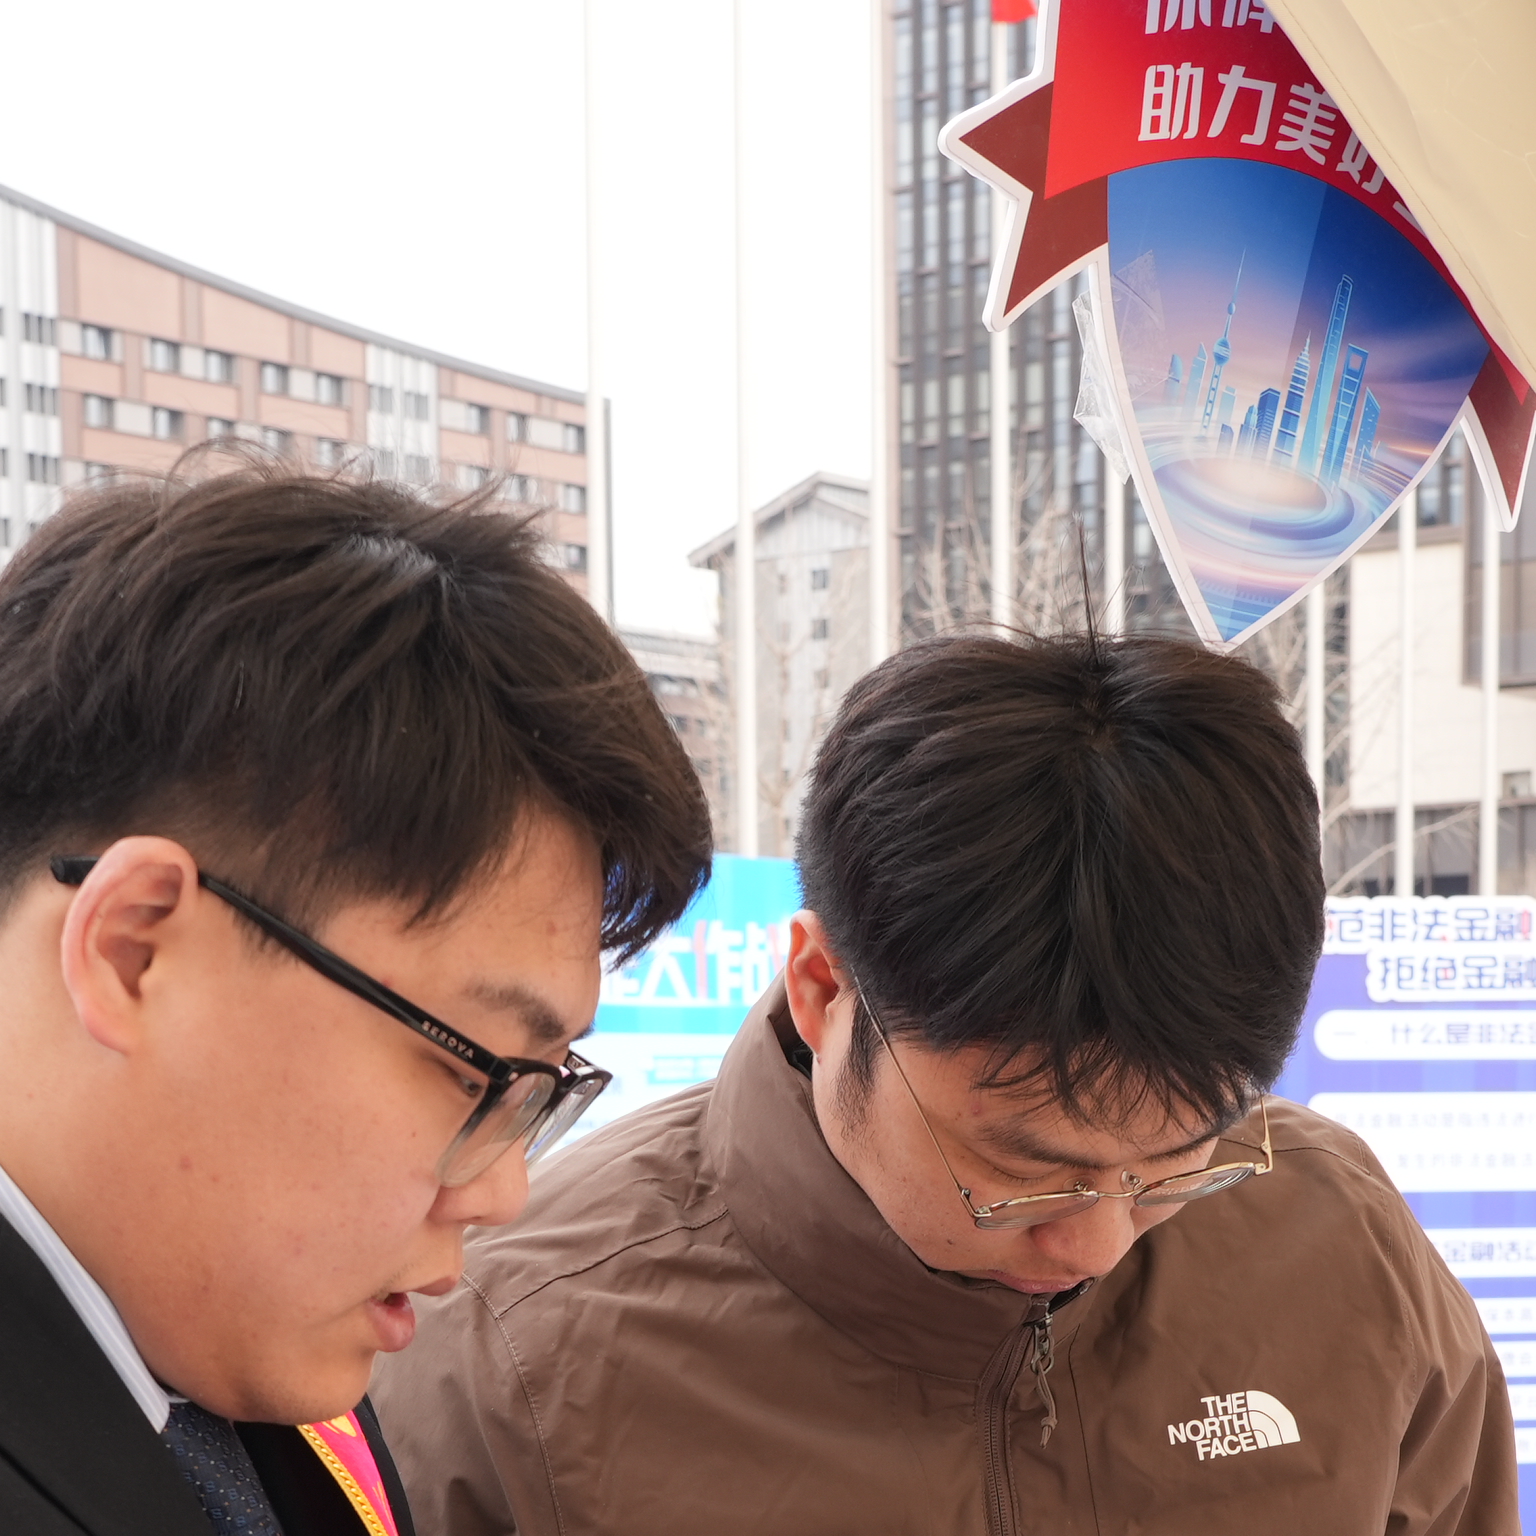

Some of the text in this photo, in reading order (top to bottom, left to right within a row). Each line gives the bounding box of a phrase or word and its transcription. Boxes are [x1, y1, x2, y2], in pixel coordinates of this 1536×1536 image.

[1200, 1391, 1247, 1417] THE
[1167, 1412, 1251, 1446] NORTH
[1195, 1431, 1258, 1462] FACE
